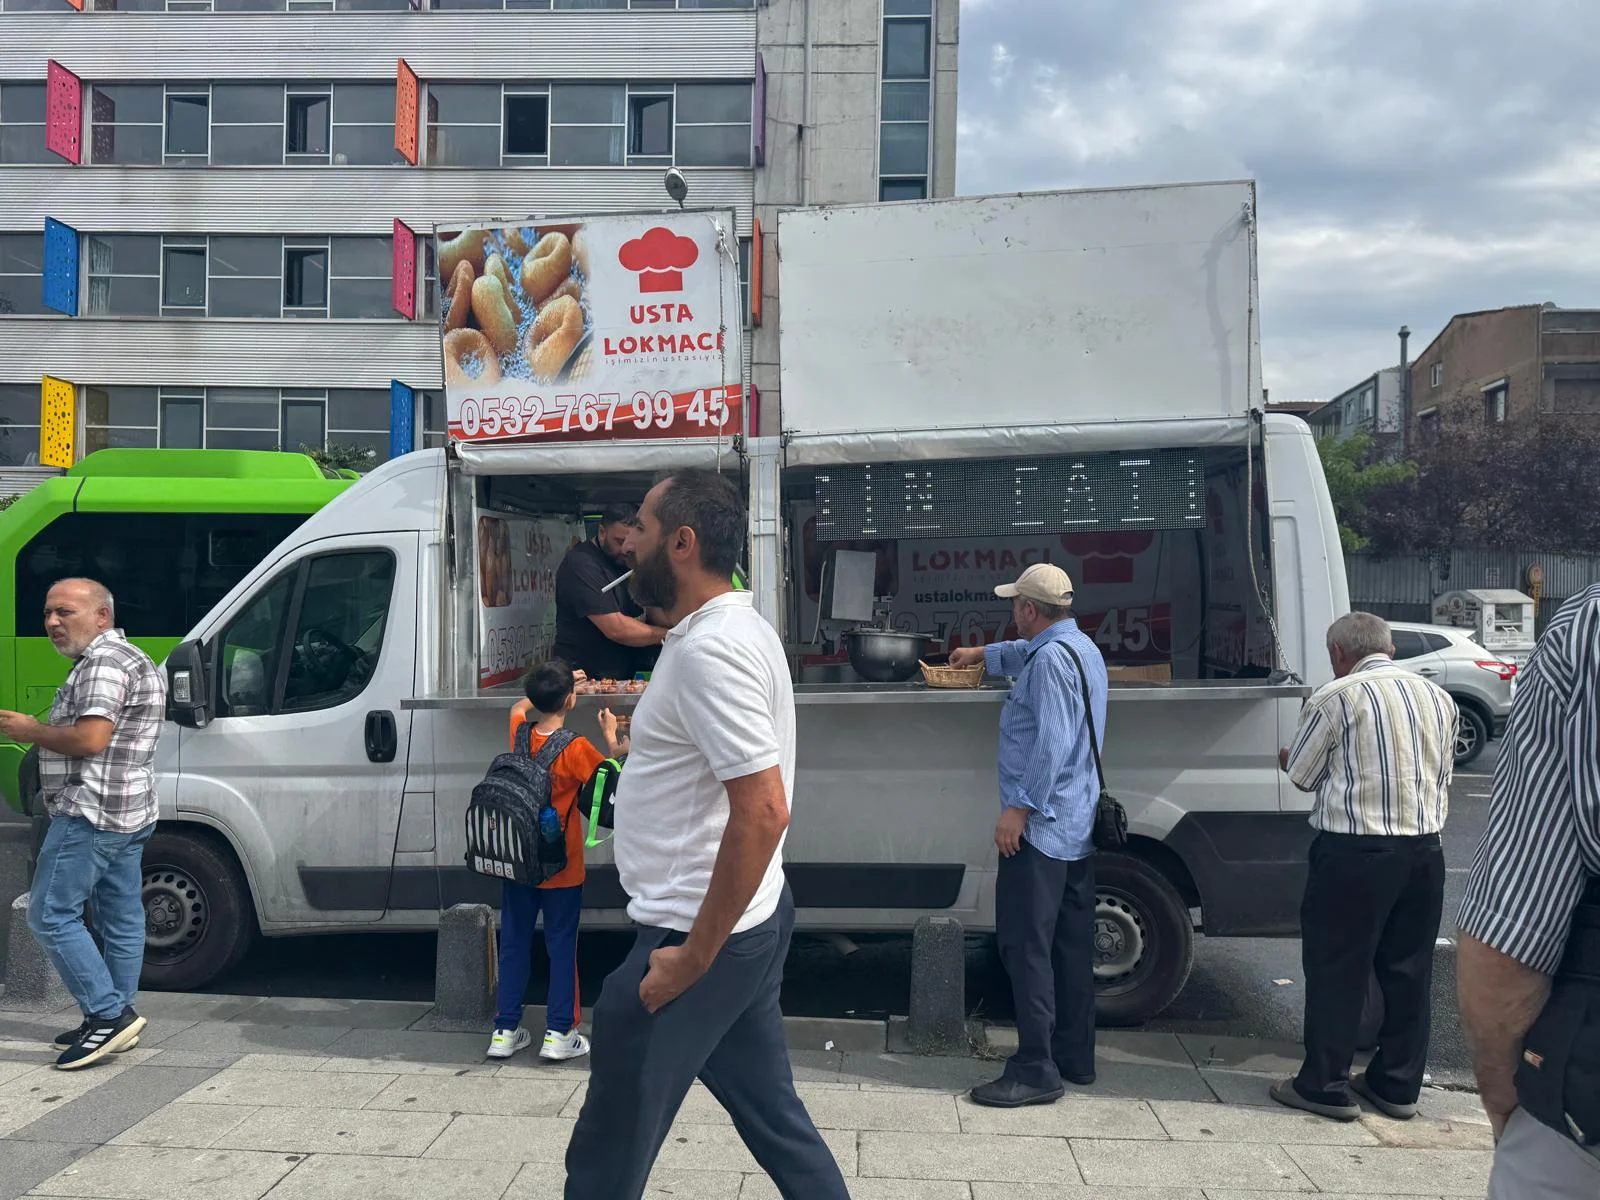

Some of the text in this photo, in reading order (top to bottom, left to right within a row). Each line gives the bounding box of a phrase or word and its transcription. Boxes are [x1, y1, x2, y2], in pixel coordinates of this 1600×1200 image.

[630, 304, 694, 324] USTA
[460, 389, 730, 436] 0532 767 99 45
[1094, 607, 1150, 651] 45
